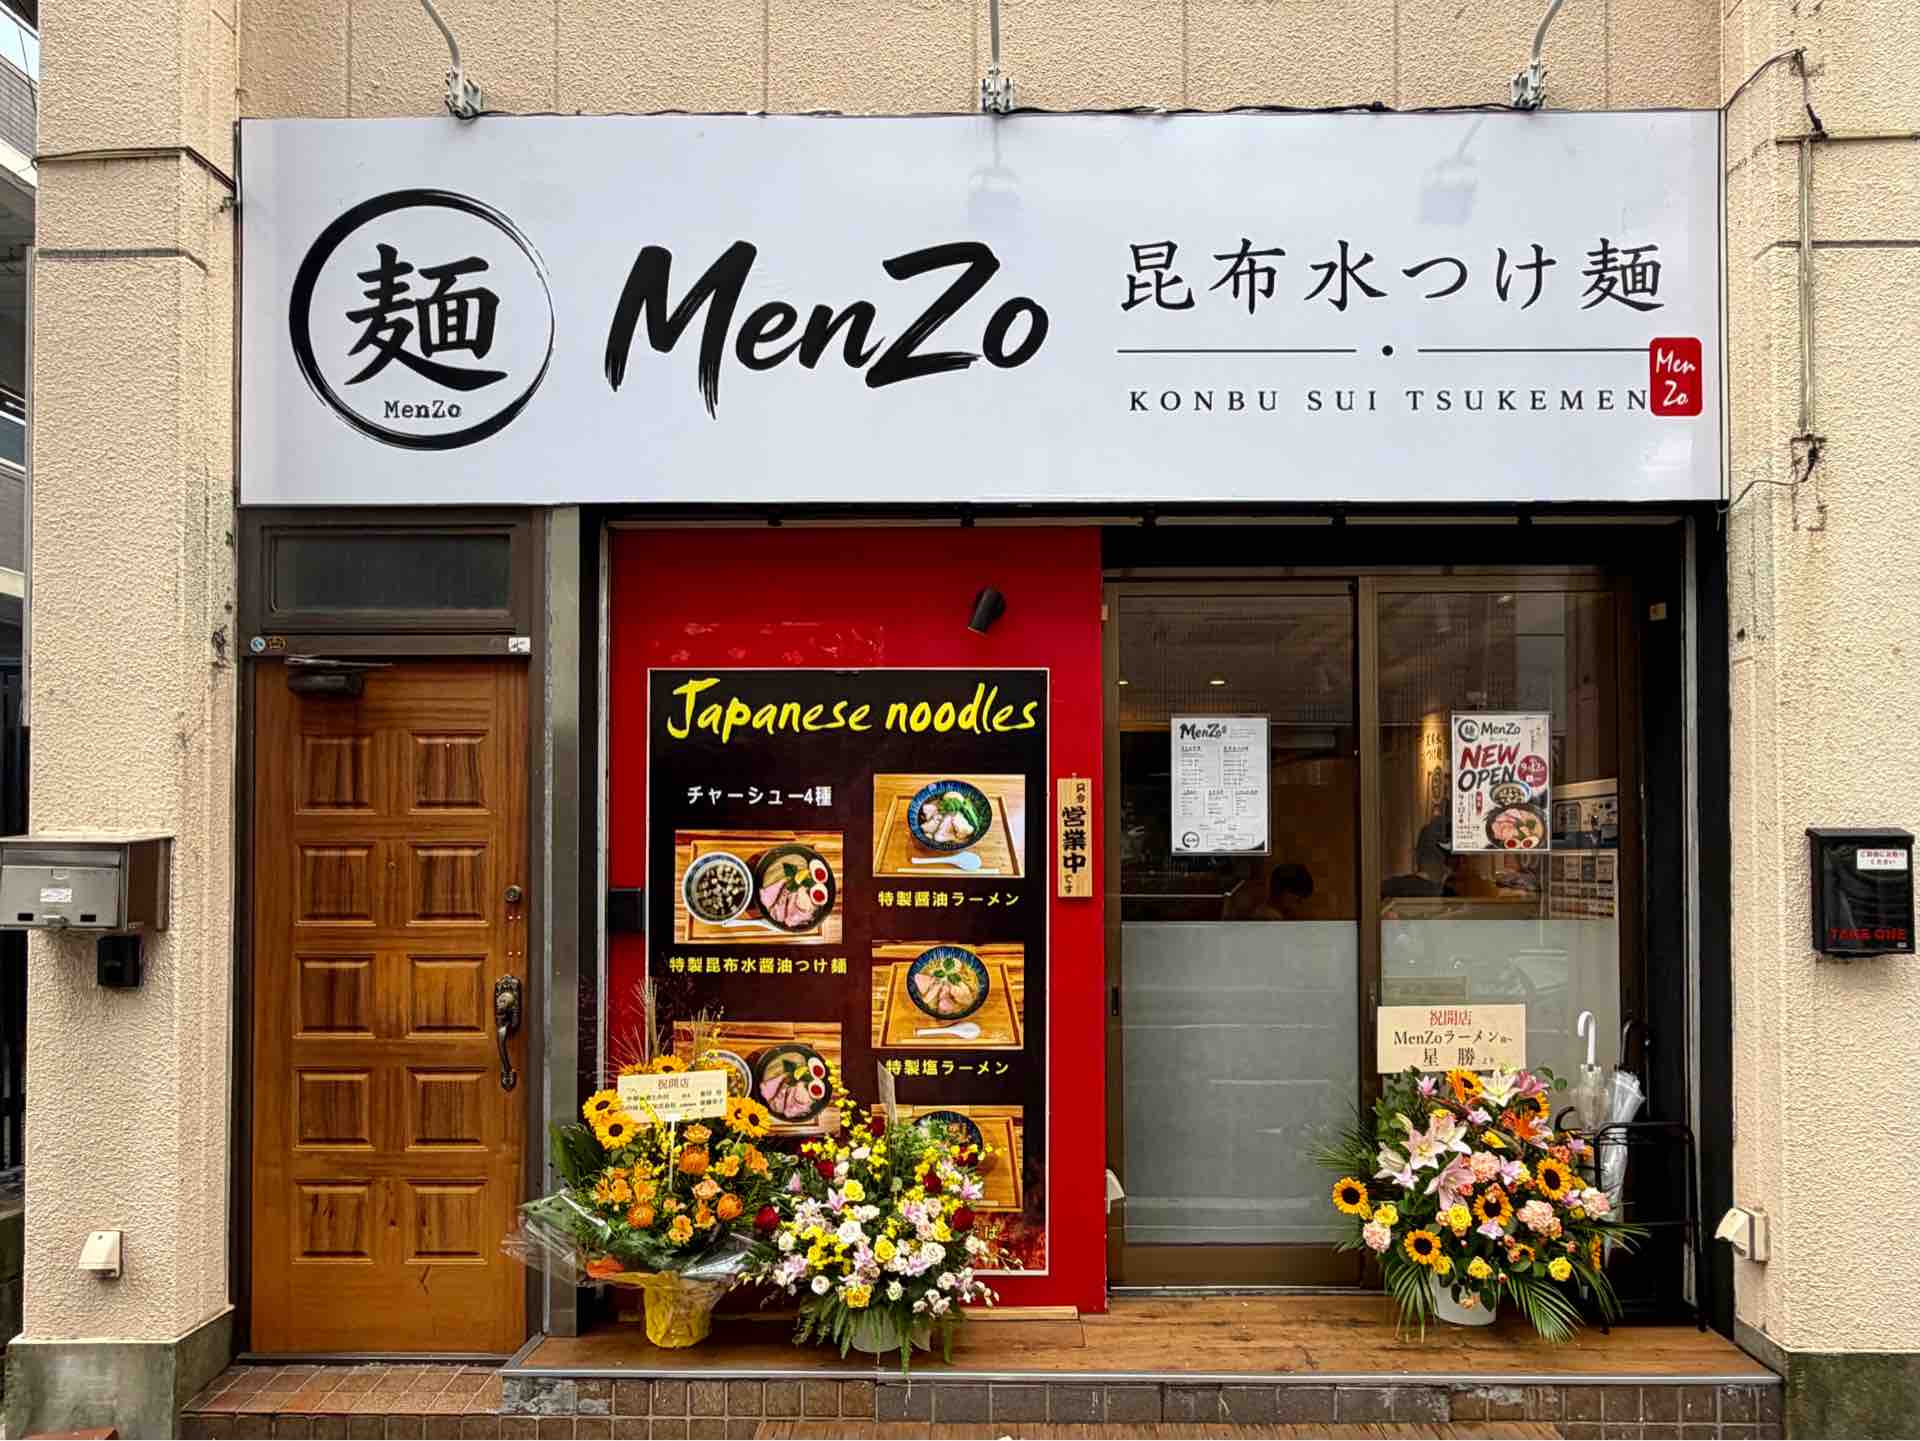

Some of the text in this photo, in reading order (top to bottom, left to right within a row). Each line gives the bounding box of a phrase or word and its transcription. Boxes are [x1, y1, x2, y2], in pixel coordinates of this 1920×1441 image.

[1120, 237, 1664, 315] 昆布水つけ麺
[345, 243, 507, 391] 麺
[604, 240, 1049, 420] MenZo
[1655, 347, 1696, 374] Men
[1129, 390, 1647, 411] KONBU SUI TSUKEMEN
[1662, 379, 1689, 407] Zo
[383, 399, 462, 419] MenZo
[667, 678, 1039, 743] Japanese noodles
[1480, 722, 1521, 735] MenZo
[1460, 743, 1520, 769] NEW
[1457, 764, 1516, 792] OPEN
[687, 786, 832, 806] チャーシュー4種
[1062, 806, 1087, 874] 営業中
